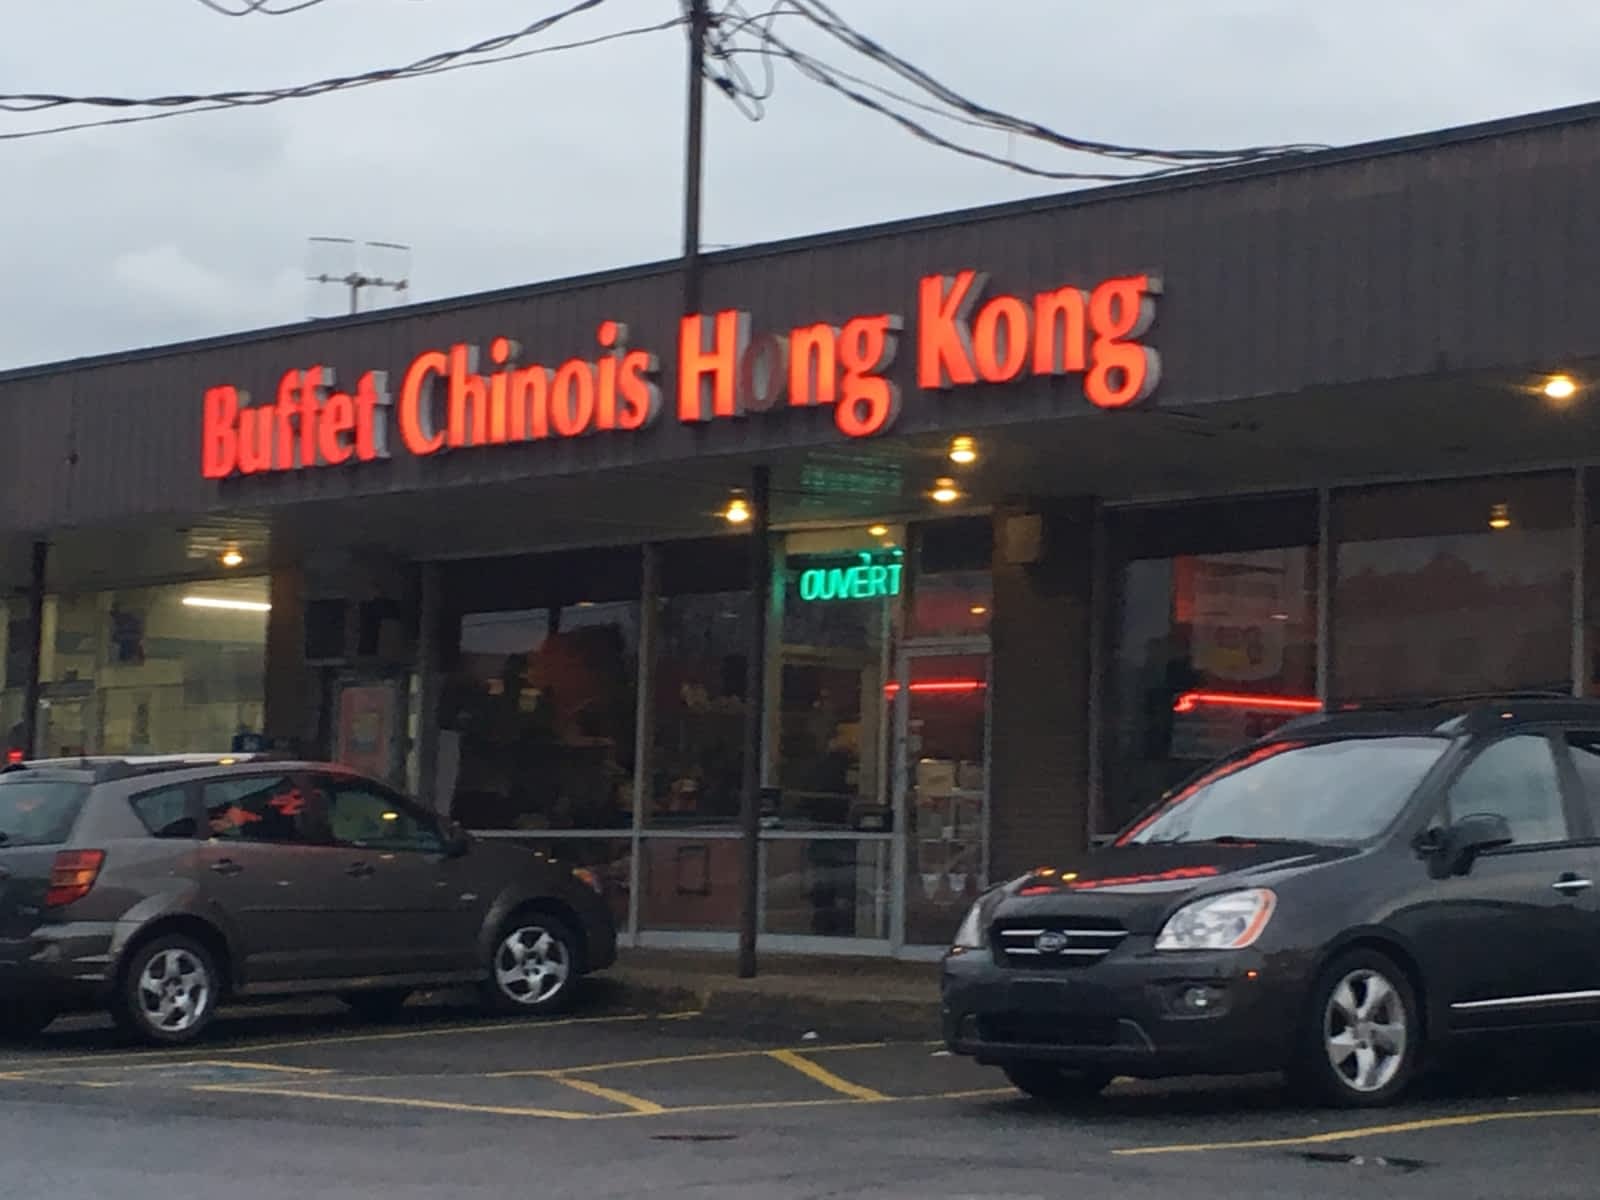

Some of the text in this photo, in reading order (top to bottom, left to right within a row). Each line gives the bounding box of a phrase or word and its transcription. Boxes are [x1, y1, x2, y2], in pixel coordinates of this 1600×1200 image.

[202, 270, 1154, 479] Buffet Chinois Hong Kong
[800, 564, 902, 600] OUVERT
